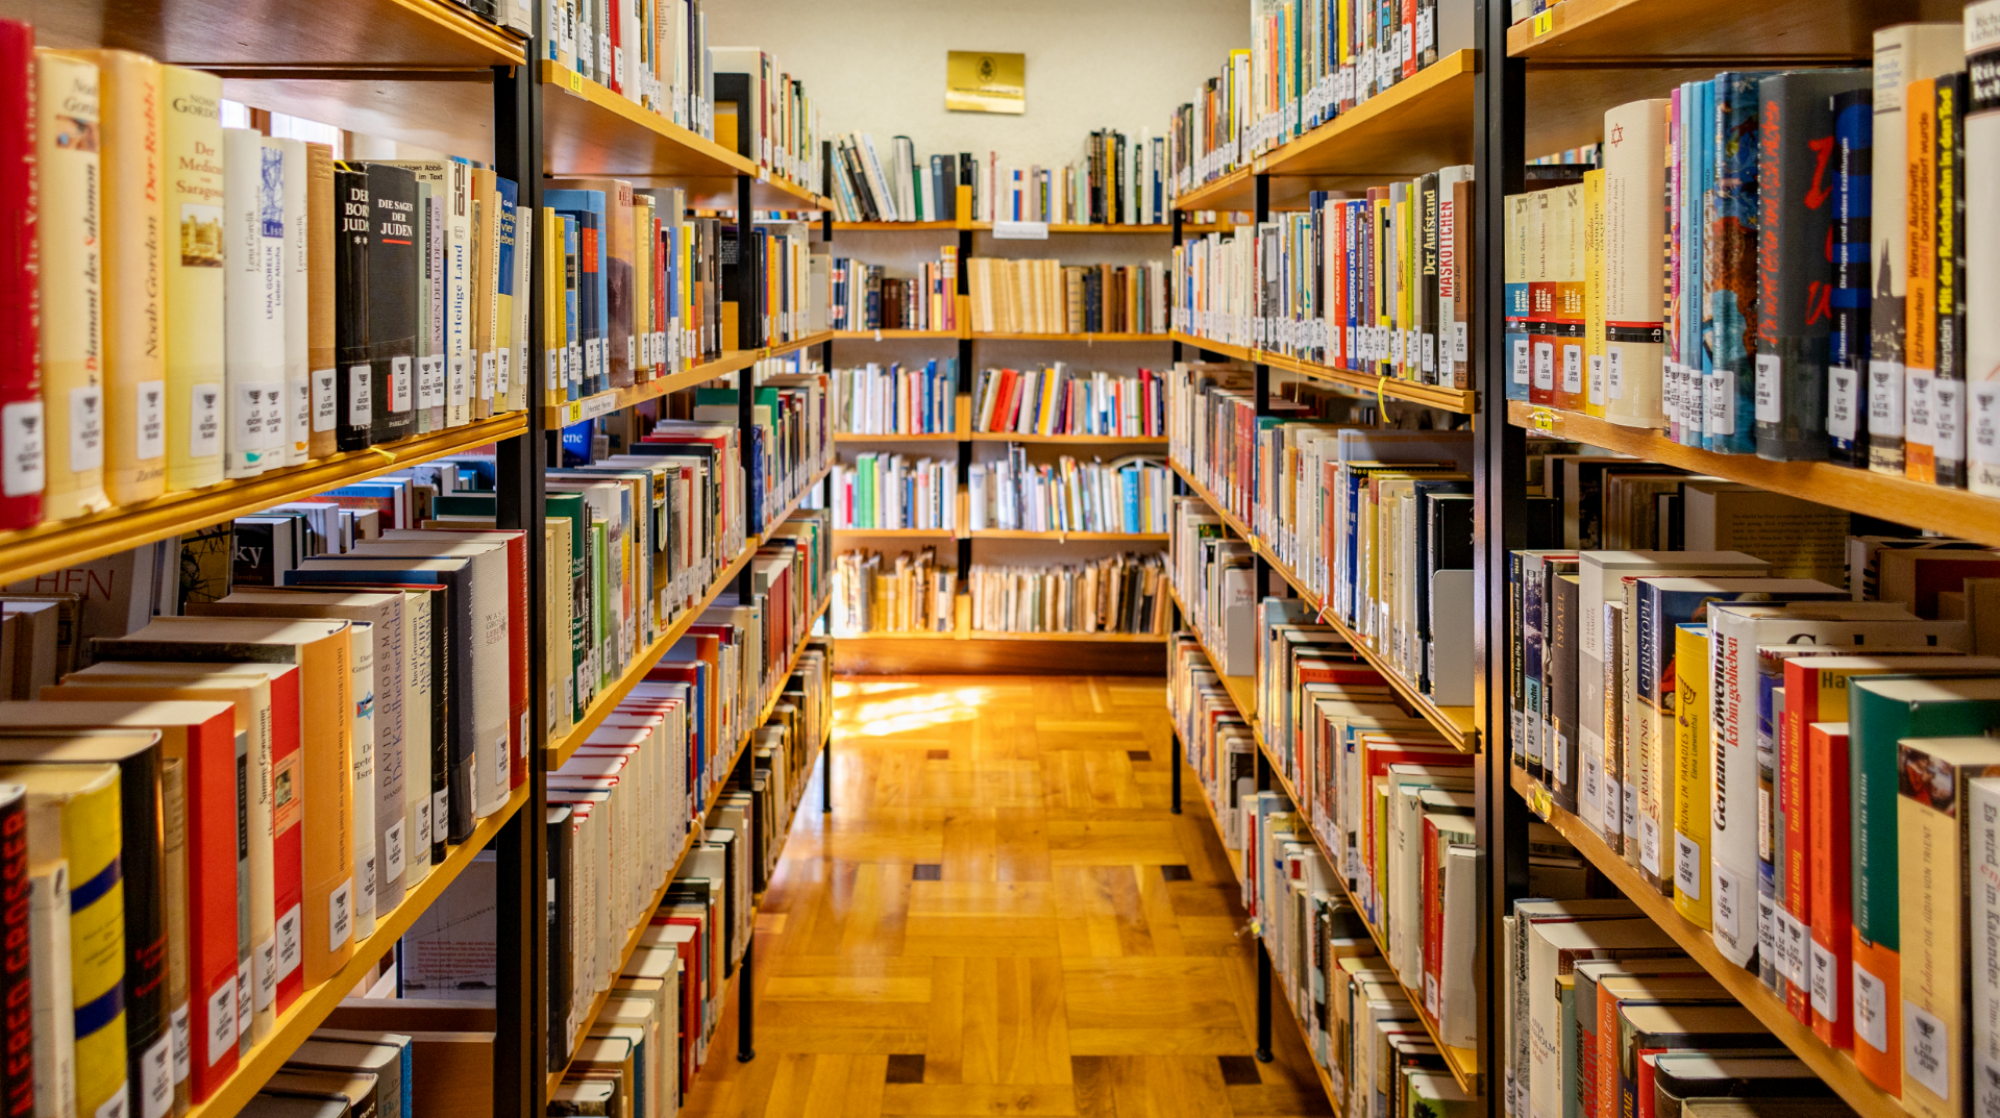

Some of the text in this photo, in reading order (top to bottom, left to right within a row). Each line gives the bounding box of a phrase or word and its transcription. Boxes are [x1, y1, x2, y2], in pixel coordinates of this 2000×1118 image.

[1541, 18, 1547, 33] L
[573, 76, 579, 90] H
[195, 141, 215, 157] Der
[1841, 138, 1849, 192] Erzählungen
[1919, 112, 1929, 155] wurde
[144, 82, 158, 358] Noah Gordon Der Rabbi
[263, 224, 283, 237] List
[377, 199, 413, 211] DIE SAGEN
[380, 222, 413, 237] JUDEN
[392, 212, 406, 222] DER
[1909, 163, 1919, 279] Warum Auschwitz
[1918, 157, 1929, 242] bombardiert
[1938, 87, 1953, 314] Mit der Reichsbahn in den Tod
[246, 211, 254, 272] Lena Gorelik
[1423, 189, 1436, 276] Der Aufstand
[1440, 201, 1453, 298] MASKOTTCHEN
[1840, 247, 1848, 274] Puppe
[84, 163, 98, 371] Diamant des Salomon
[454, 245, 464, 334] Heilige Land
[1840, 277, 1848, 289] Die
[1914, 287, 1925, 364] Lichtenstein
[573, 405, 579, 419] H
[1555, 592, 1566, 650] ISRAEL
[1640, 598, 1651, 692] CHRISTOPH
[382, 605, 392, 788] DAVID GROSSMAN
[391, 600, 403, 782] Der Kindheitserfinder
[1725, 637, 1741, 748] Ich bin geblieben
[259, 709, 267, 804] Sammy Gronemann
[1640, 717, 1649, 813] VERMÄCHTNIS
[1681, 732, 1690, 798] IM PARADIES
[1759, 793, 1767, 856] Chanukkabaum
[1790, 711, 1801, 891] Loewy Taxi nach Auschwitz
[1923, 825, 1932, 862] TRIENT
[1983, 803, 1998, 867] Es wird
[1924, 868, 1932, 889] VON
[1924, 893, 1932, 923] JÜDIN
[3, 809, 34, 1117] ALFRED GROSSER
[1924, 927, 1932, 947] DIE
[1986, 883, 2000, 989] im Kalender
[1604, 1002, 1612, 1112] Schmerz und Zorn
